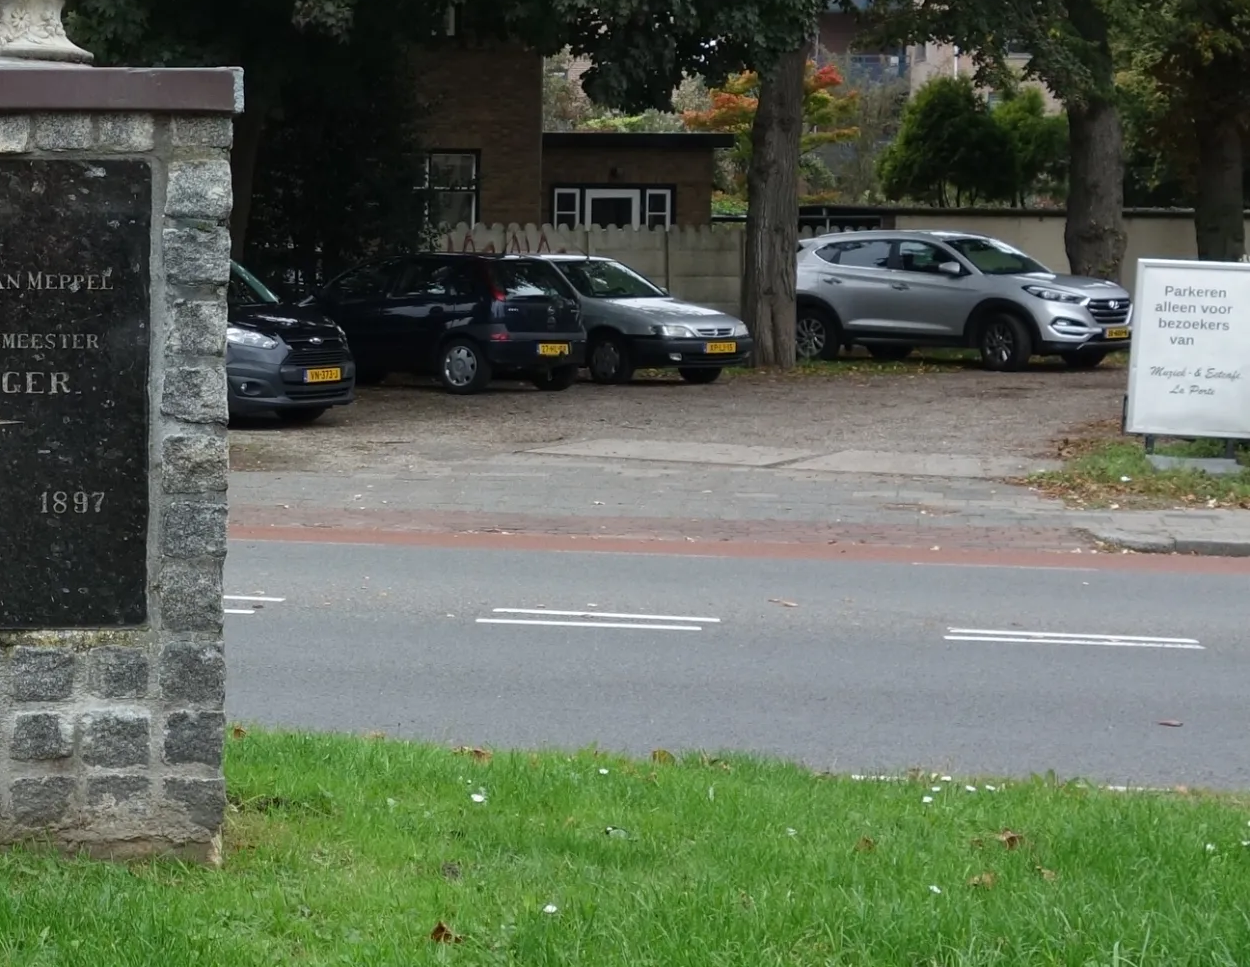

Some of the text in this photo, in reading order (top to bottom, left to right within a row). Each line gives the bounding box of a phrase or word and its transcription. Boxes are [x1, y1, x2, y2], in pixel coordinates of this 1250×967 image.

[27, 271, 113, 290] MEPPEL
[1165, 285, 1227, 298] Parkeren
[1155, 301, 1233, 314] alleen voor
[1158, 318, 1230, 331] bezoekers
[1170, 336, 1194, 345] van
[310, 369, 338, 380] VN-373-J
[39, 491, 105, 514] 1897
